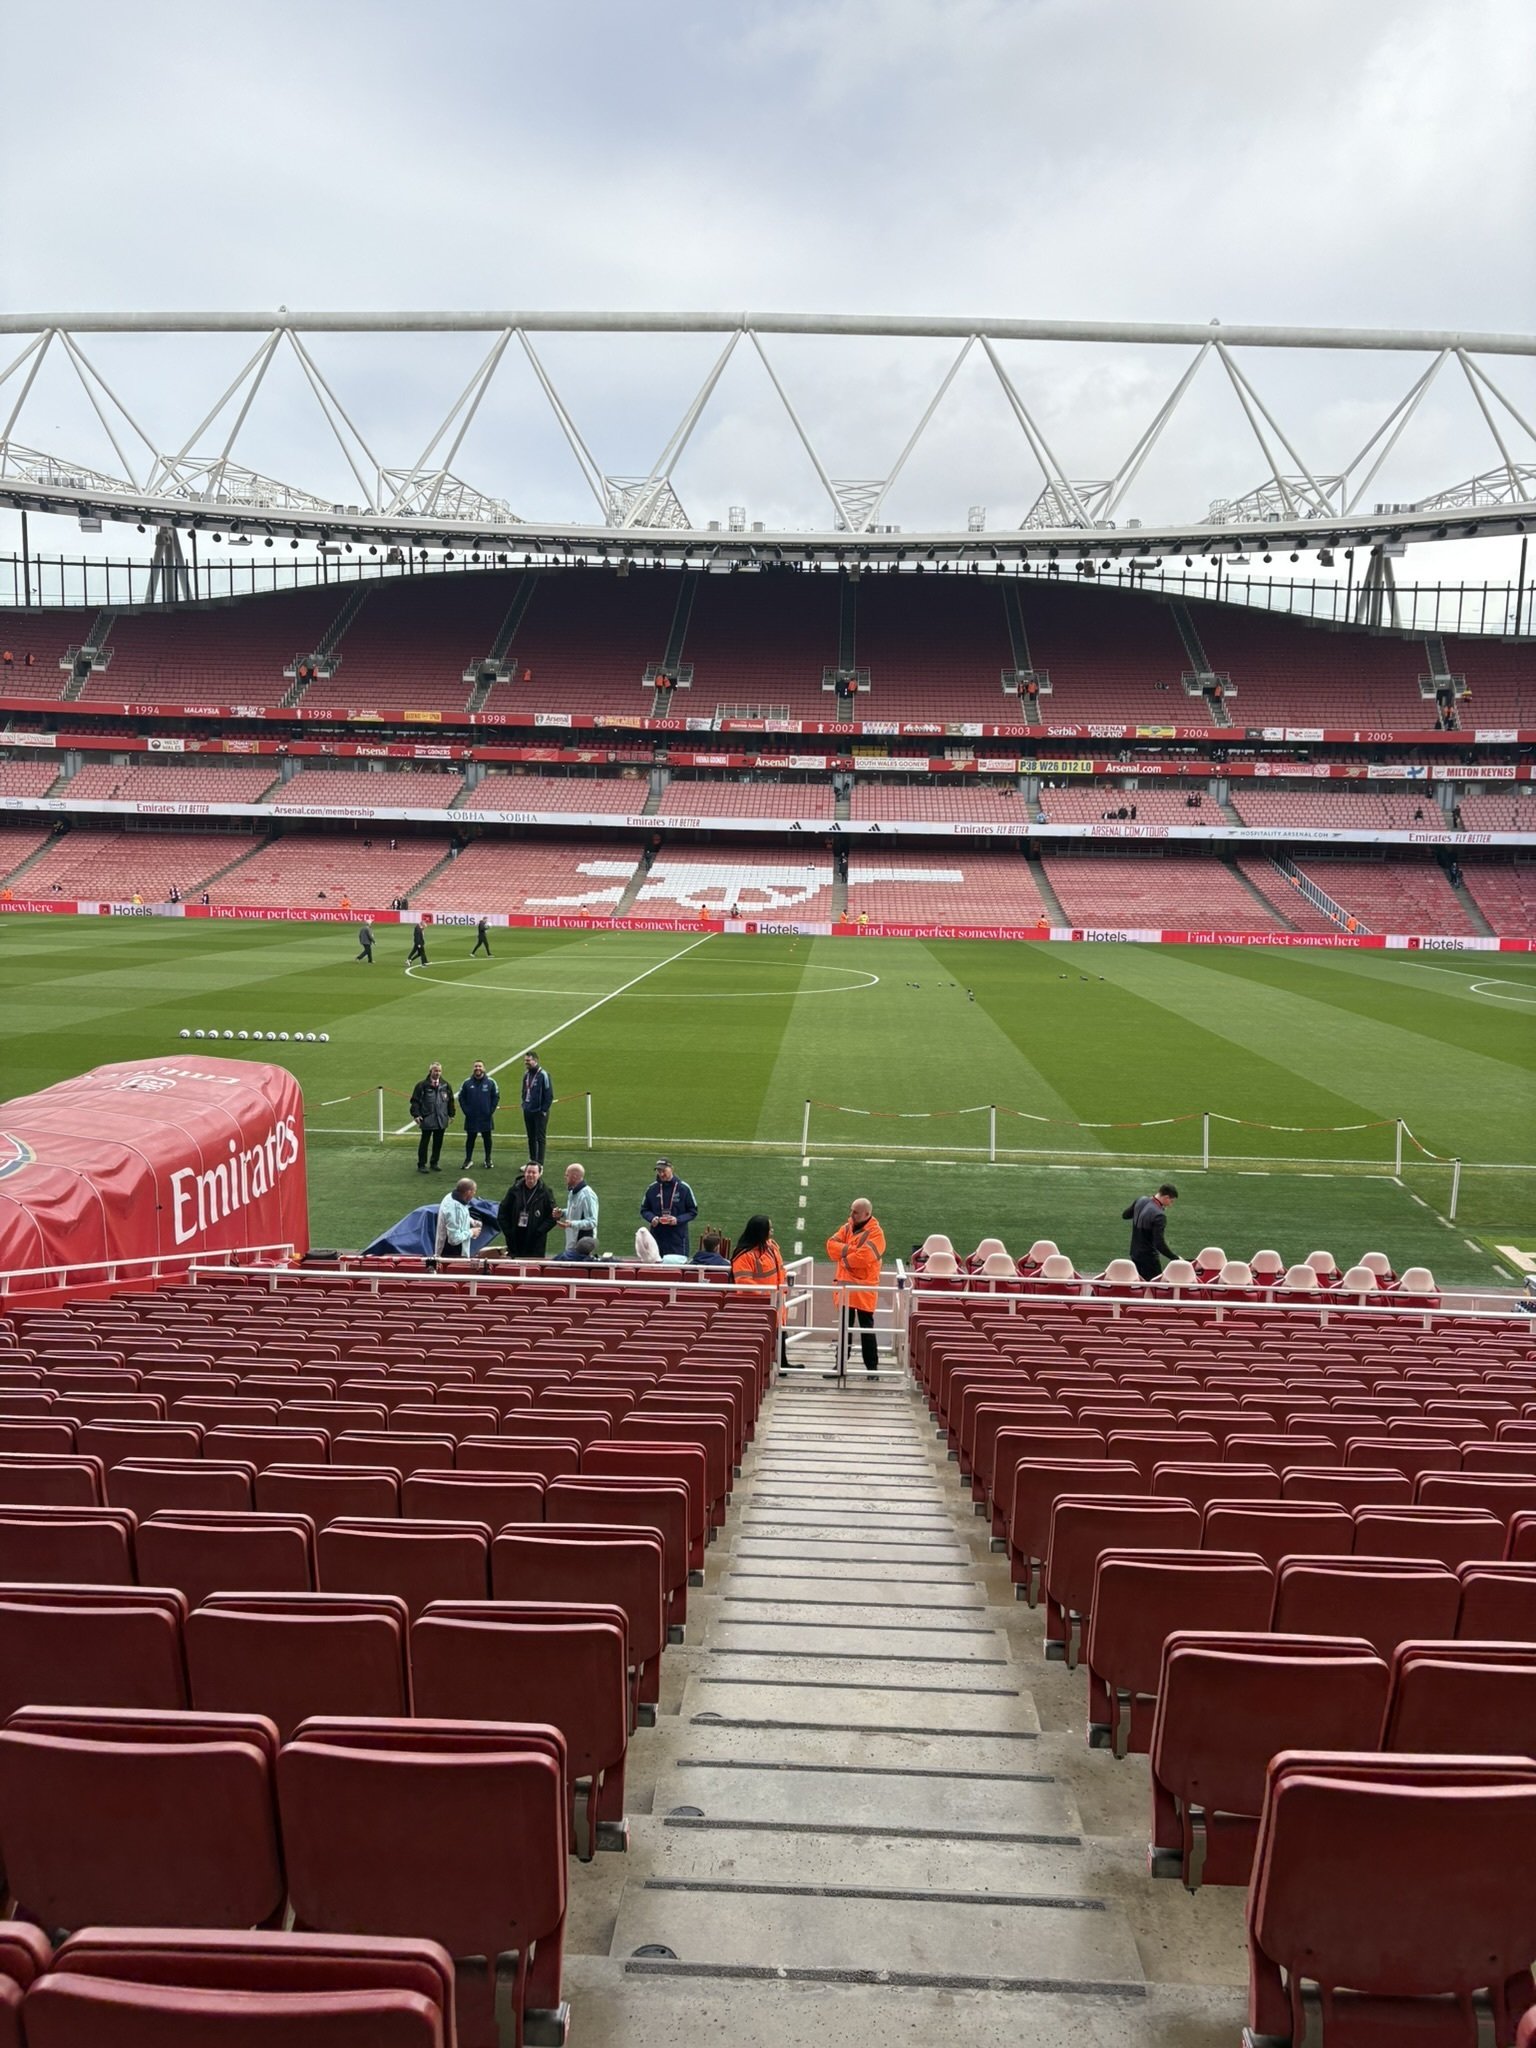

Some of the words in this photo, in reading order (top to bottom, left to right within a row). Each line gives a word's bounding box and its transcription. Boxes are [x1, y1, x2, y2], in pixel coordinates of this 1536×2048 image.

[135, 706, 160, 715] 1994
[184, 707, 220, 715] MALAYSIA
[308, 710, 333, 719] 1998
[482, 715, 506, 724] 1998
[546, 714, 569, 722] Arsenal
[655, 720, 680, 729] 2002
[829, 724, 854, 732] 2002
[1005, 727, 1030, 735] 2003
[1048, 726, 1077, 736] Serbia
[1183, 729, 1209, 738] 2004
[1367, 733, 1394, 741] 2005
[755, 757, 788, 767] Arsenal
[1020, 761, 1037, 771] P38
[1039, 762, 1059, 772] W26
[1061, 762, 1078, 772] D12
[1105, 763, 1162, 773] Arsenal.com
[1446, 767, 1479, 777] MILTON
[1481, 768, 1514, 777] KEYNES
[136, 803, 175, 813] Emirates
[178, 804, 188, 813] FLY
[189, 804, 209, 813] BETTER
[274, 806, 375, 818] Arsenal.com/membership
[446, 811, 485, 821] SOBHA
[500, 813, 538, 823] SOBHA
[626, 817, 665, 827] Emirates
[668, 818, 678, 827] FLY
[679, 818, 701, 827] BETTER
[954, 825, 993, 834] Emirates
[996, 825, 1007, 834] FLY
[1007, 826, 1029, 835] BETTER
[1409, 833, 1452, 843] Emirates
[1455, 834, 1466, 843] FLY
[1467, 834, 1492, 843] BETTER
[113, 905, 153, 916] Hotels
[209, 906, 236, 917] Find
[238, 909, 265, 919] your
[267, 907, 308, 920] perfect
[309, 909, 376, 921] somewhere
[436, 914, 476, 926] Hotels
[534, 916, 560, 927] Find
[563, 918, 590, 929] your
[591, 917, 633, 930] perfect
[634, 919, 700, 931] somewhere
[760, 923, 799, 935] Hotels
[856, 925, 883, 936] Find
[886, 927, 913, 938] your
[915, 925, 956, 938] perfect
[958, 927, 1025, 939] somewhere
[1086, 930, 1127, 943] Hotels
[1187, 931, 1215, 943] Find
[1217, 934, 1245, 945] your
[1247, 932, 1290, 946] perfect
[1292, 934, 1361, 947] somewhere
[1422, 938, 1464, 950] Hotels
[170, 1114, 299, 1246] Emirates
